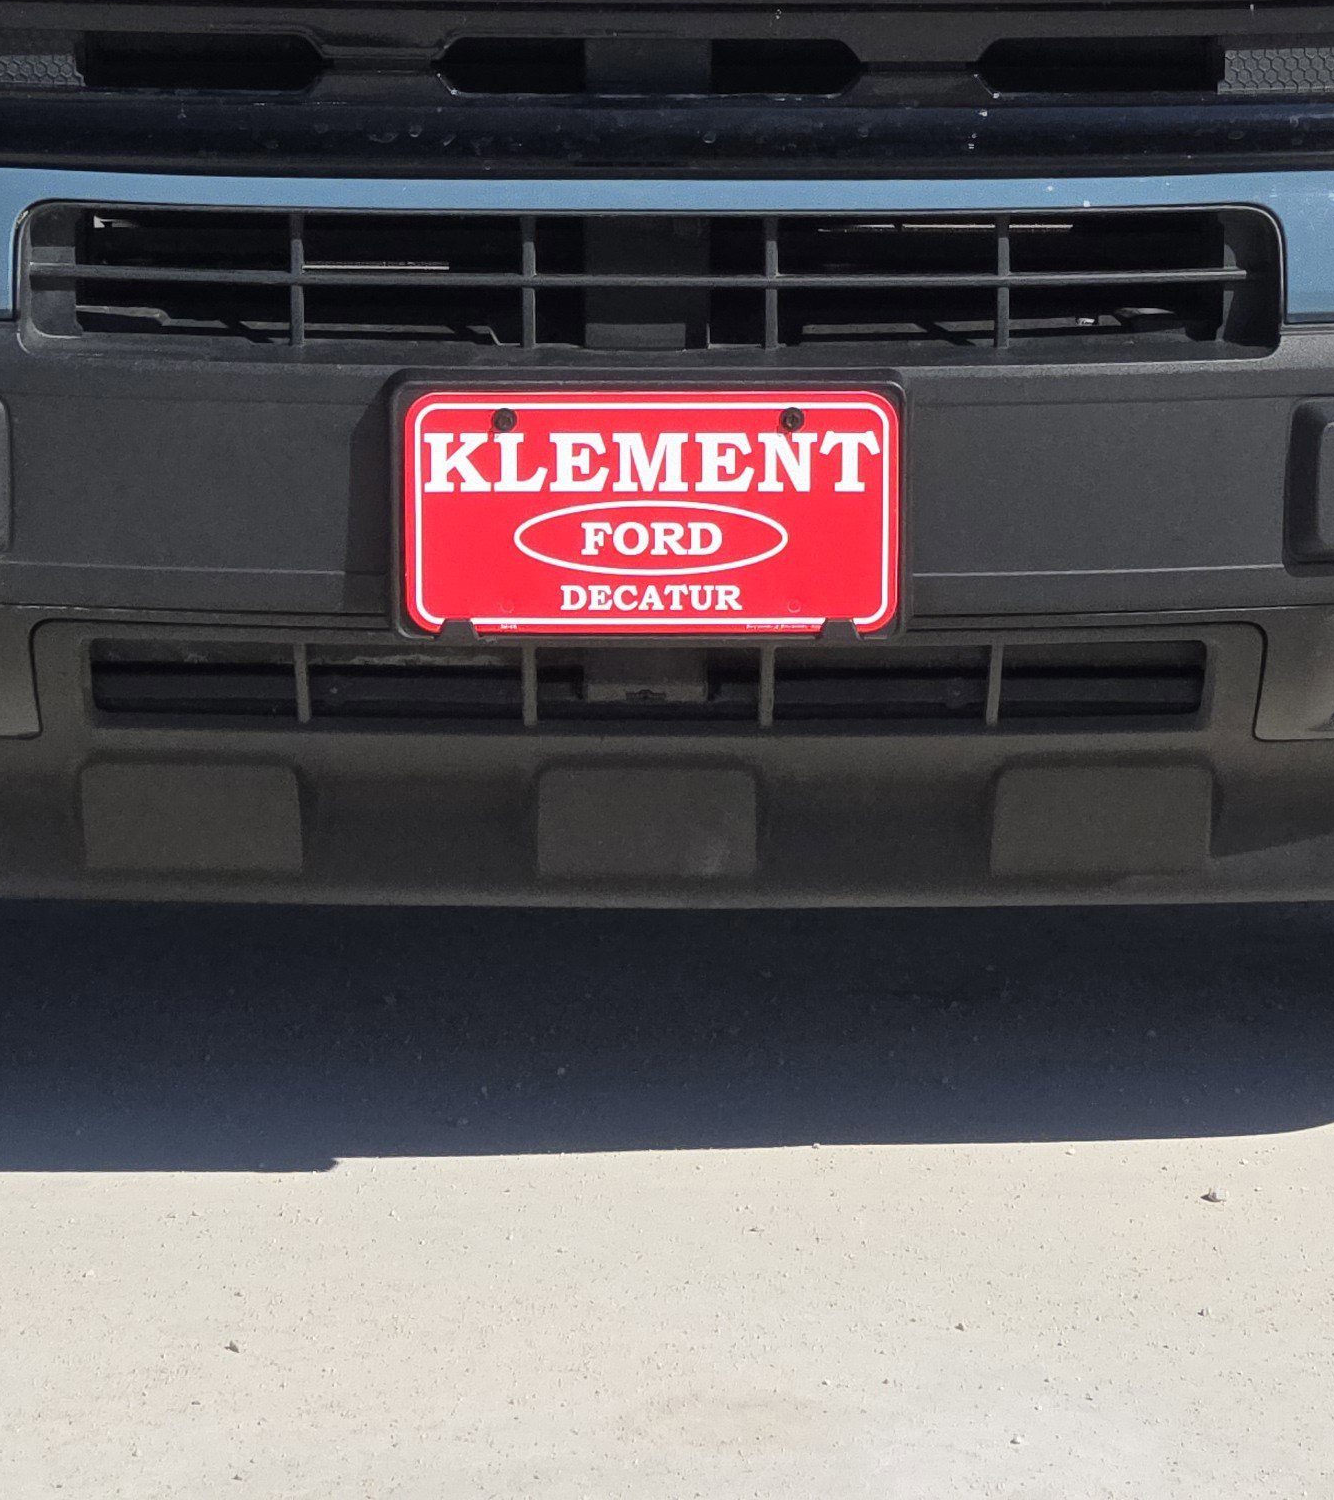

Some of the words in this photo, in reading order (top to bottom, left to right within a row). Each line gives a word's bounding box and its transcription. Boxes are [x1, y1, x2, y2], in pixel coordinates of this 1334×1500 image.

[423, 430, 881, 494] KLEMENT
[579, 521, 724, 557] FORD
[560, 583, 743, 612] DECATUR
